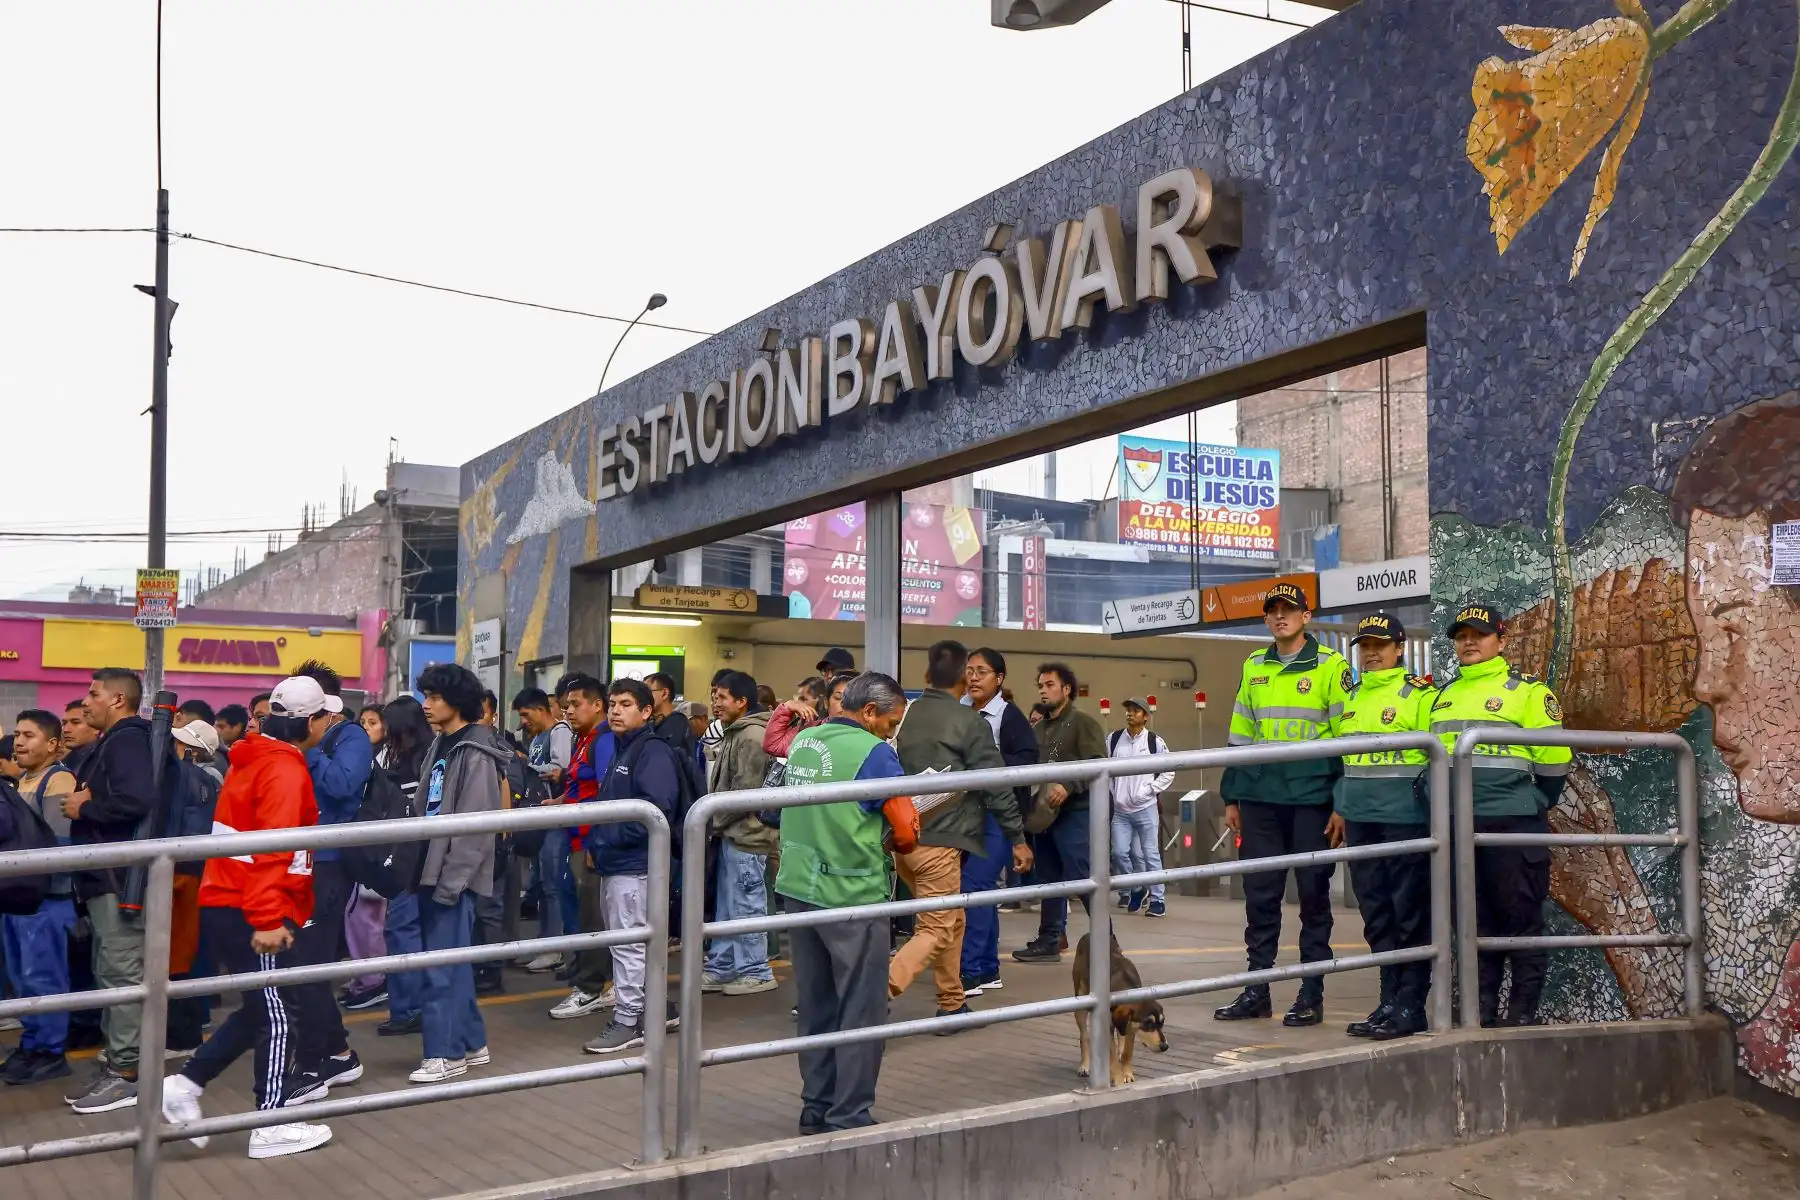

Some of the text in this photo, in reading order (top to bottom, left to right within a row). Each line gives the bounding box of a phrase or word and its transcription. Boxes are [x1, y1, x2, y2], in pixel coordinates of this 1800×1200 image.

[598, 167, 1216, 498] ESTACIÓN BAYÓVAR
[1168, 452, 1273, 480] ESCUELA
[1167, 478, 1275, 508] DE JESÚS
[1140, 503, 1260, 525] DEL COLEGIO
[1129, 515, 1271, 536] A LA UNIVERSIDAD
[1233, 536, 1254, 548] 102
[1213, 548, 1246, 558] MARISCAL
[139, 580, 176, 589] AMARRES
[1357, 569, 1417, 592] BAYÓVAR
[833, 589, 850, 599] LAS
[660, 597, 709, 607] de Tarjetas
[1131, 603, 1146, 612] Venta
[1151, 600, 1173, 610] Recarga
[1138, 614, 1167, 624] de Tarjetas
